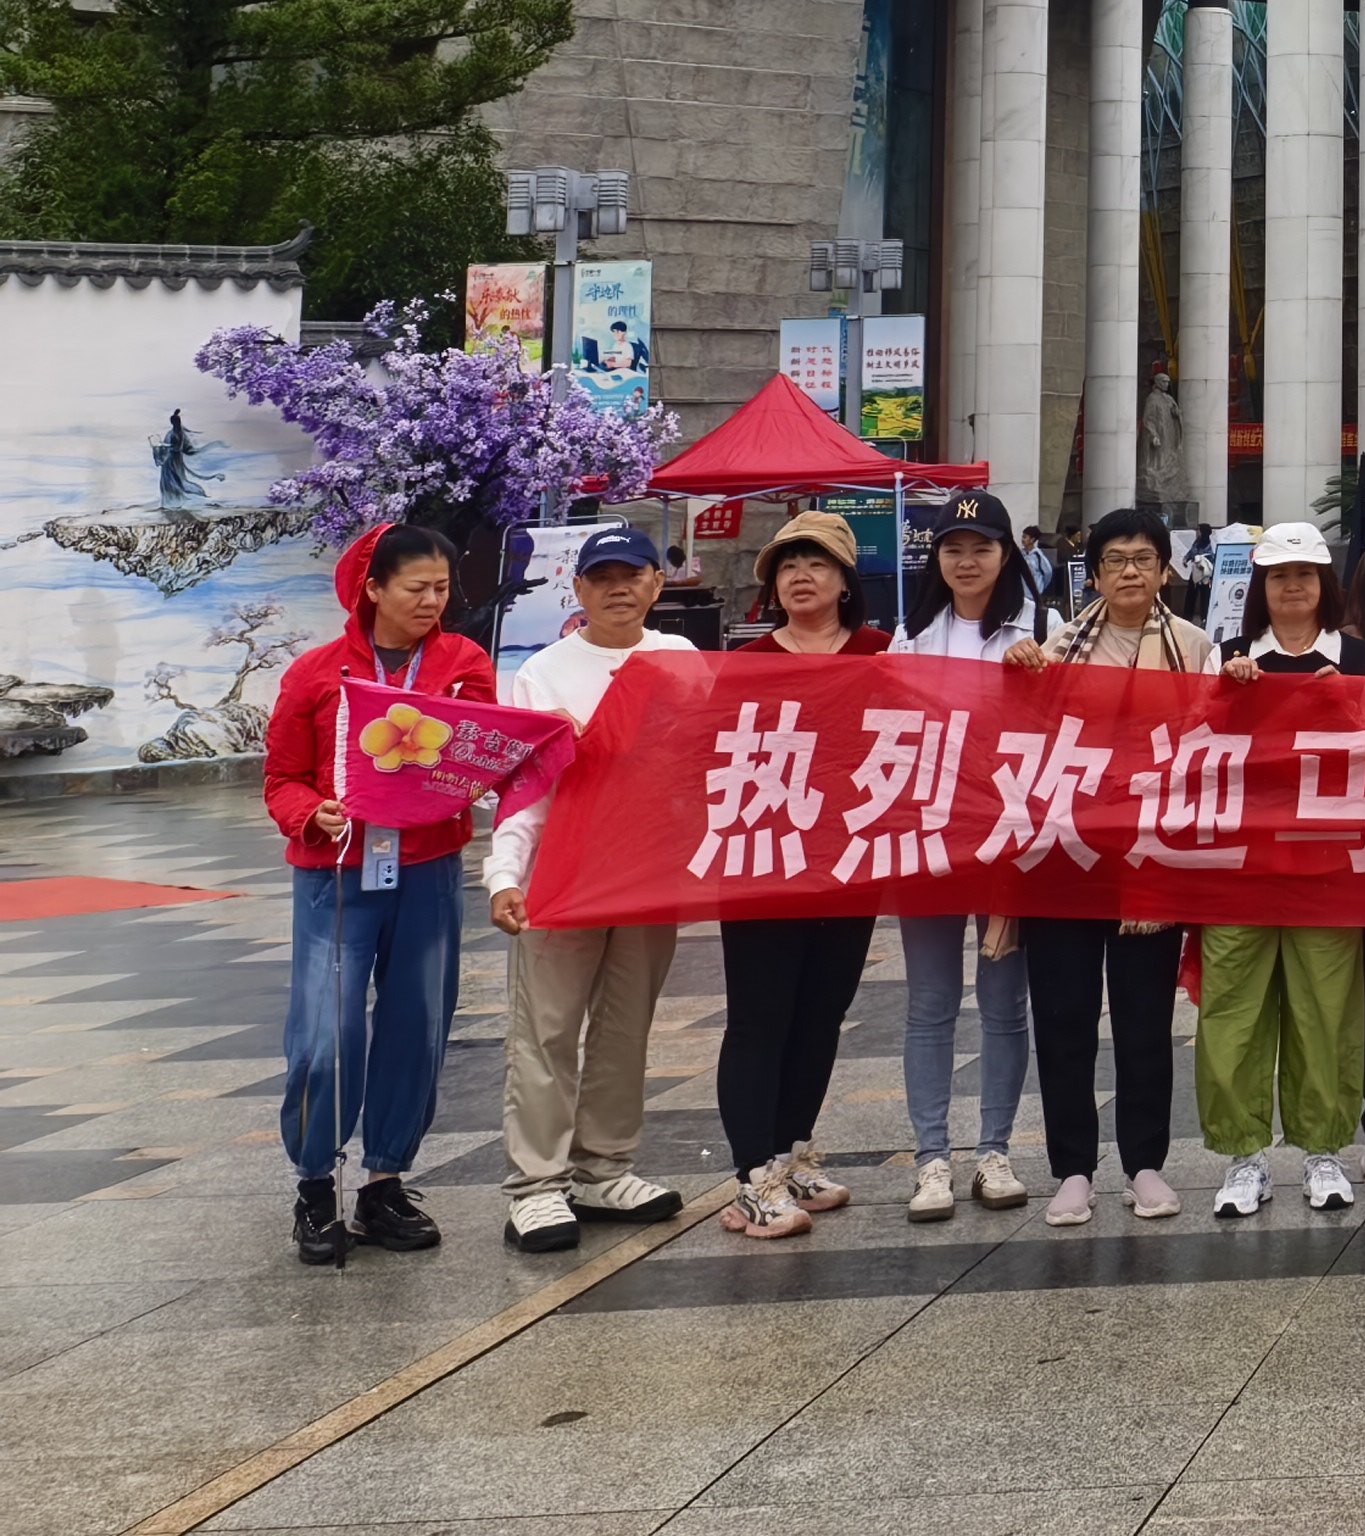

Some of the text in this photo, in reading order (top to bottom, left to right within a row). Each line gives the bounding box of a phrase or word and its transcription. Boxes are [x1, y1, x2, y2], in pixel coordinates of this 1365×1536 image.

[865, 347, 921, 357] 推动移风易俗
[865, 359, 921, 370] 树立文明乡风
[956, 499, 979, 519] NY
